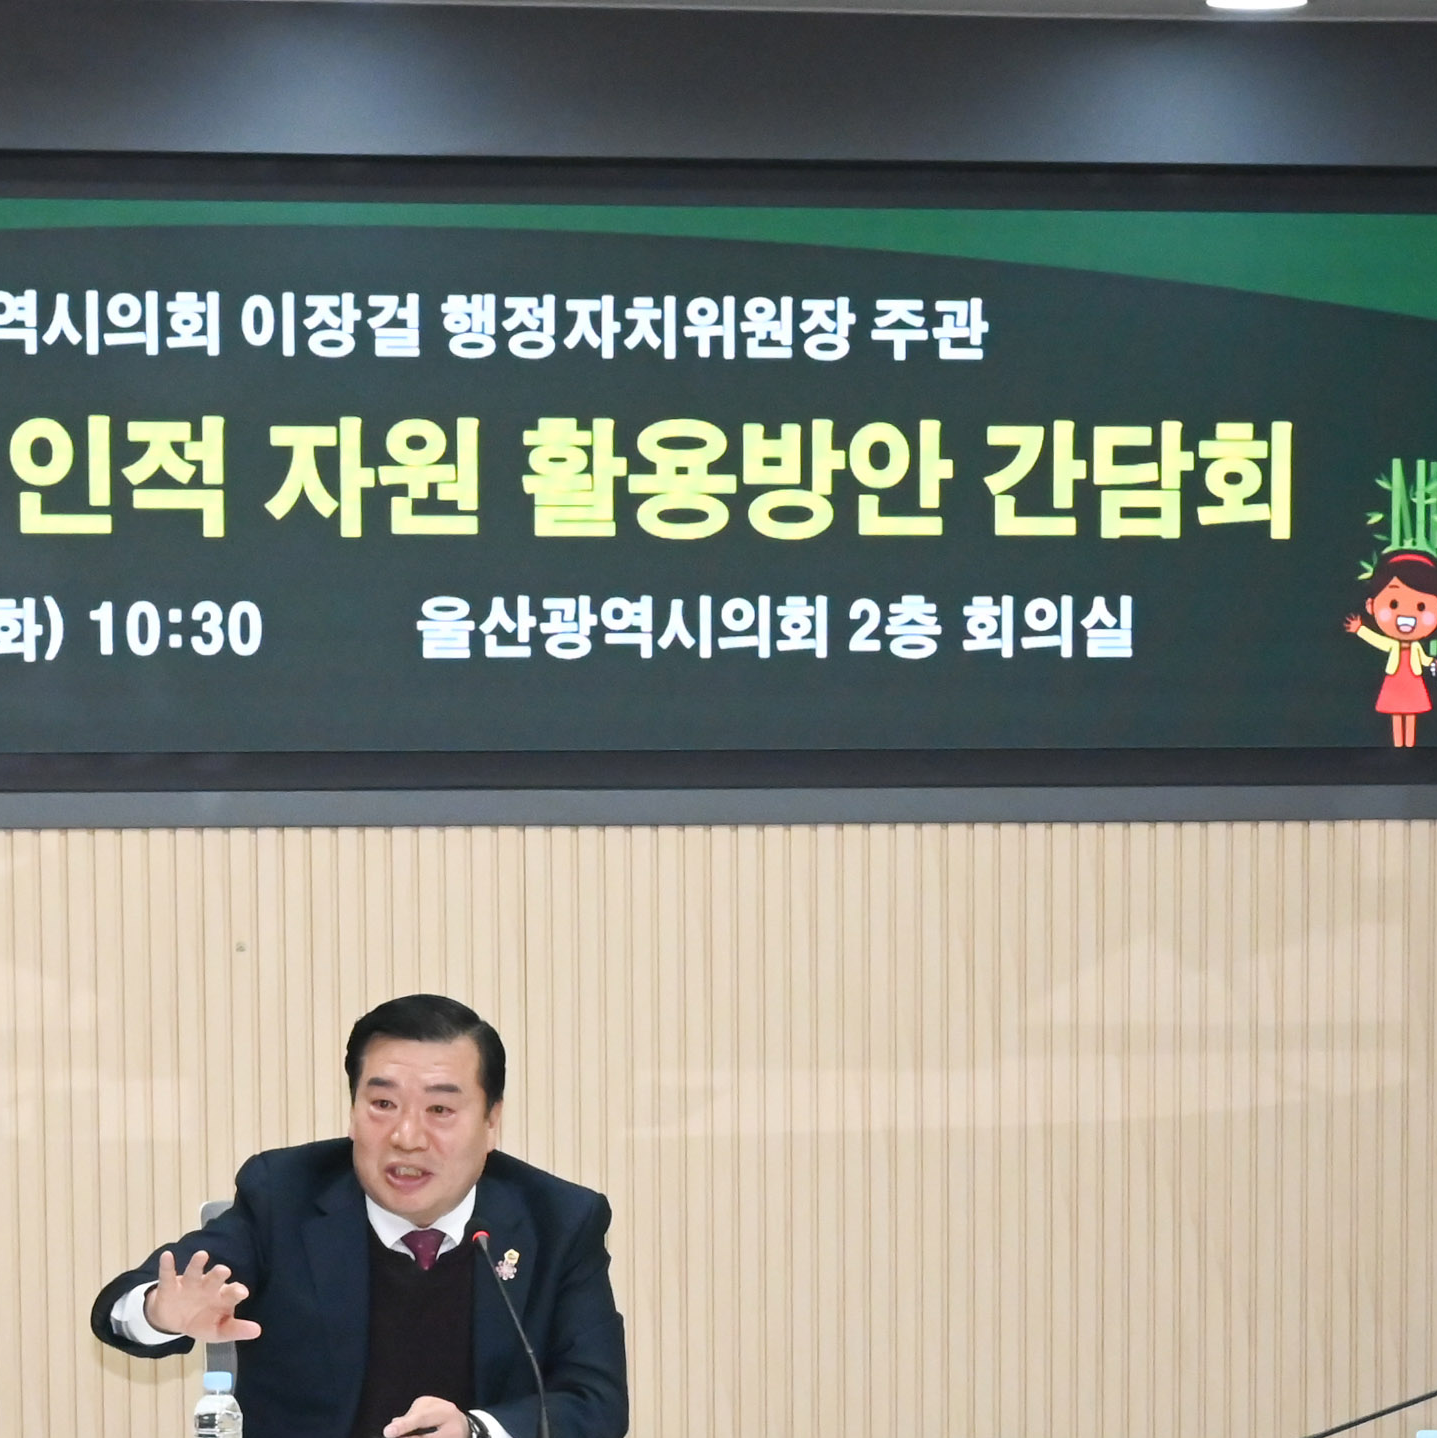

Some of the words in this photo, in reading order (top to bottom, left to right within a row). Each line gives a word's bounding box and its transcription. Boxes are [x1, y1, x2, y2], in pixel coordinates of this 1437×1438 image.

[241, 291, 421, 359] 이장걸
[440, 293, 857, 362] 행정자치위원장
[870, 297, 990, 361] 주관
[8, 414, 225, 539] 인적
[264, 416, 480, 539] 자원
[520, 417, 954, 541] 활용방안
[982, 418, 1293, 541] 간담회
[89, 600, 263, 657] 10:30
[416, 594, 828, 660] 울산광역시의회
[848, 594, 943, 660] 2층
[962, 594, 1133, 659] 회의실
